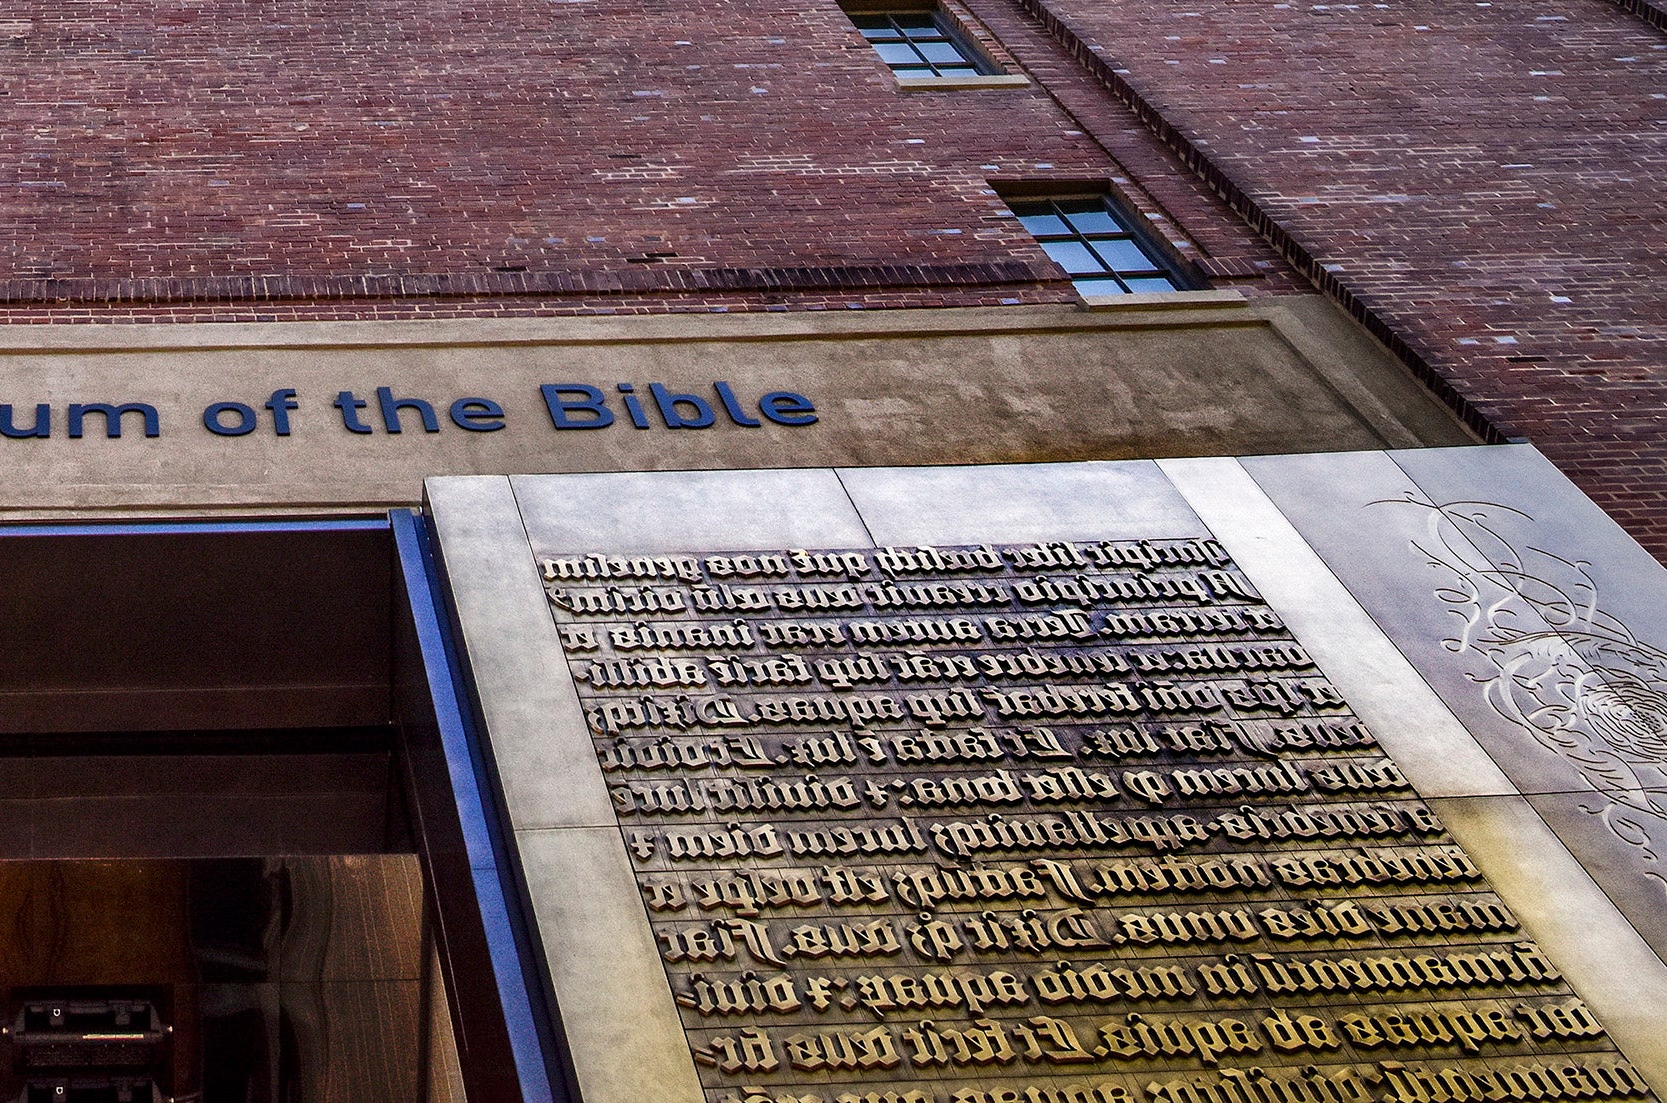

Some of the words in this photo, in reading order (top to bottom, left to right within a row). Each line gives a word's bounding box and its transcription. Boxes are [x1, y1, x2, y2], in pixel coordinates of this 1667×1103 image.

[202, 388, 299, 437] of
[334, 386, 506, 436] the
[539, 381, 819, 431] Bible
